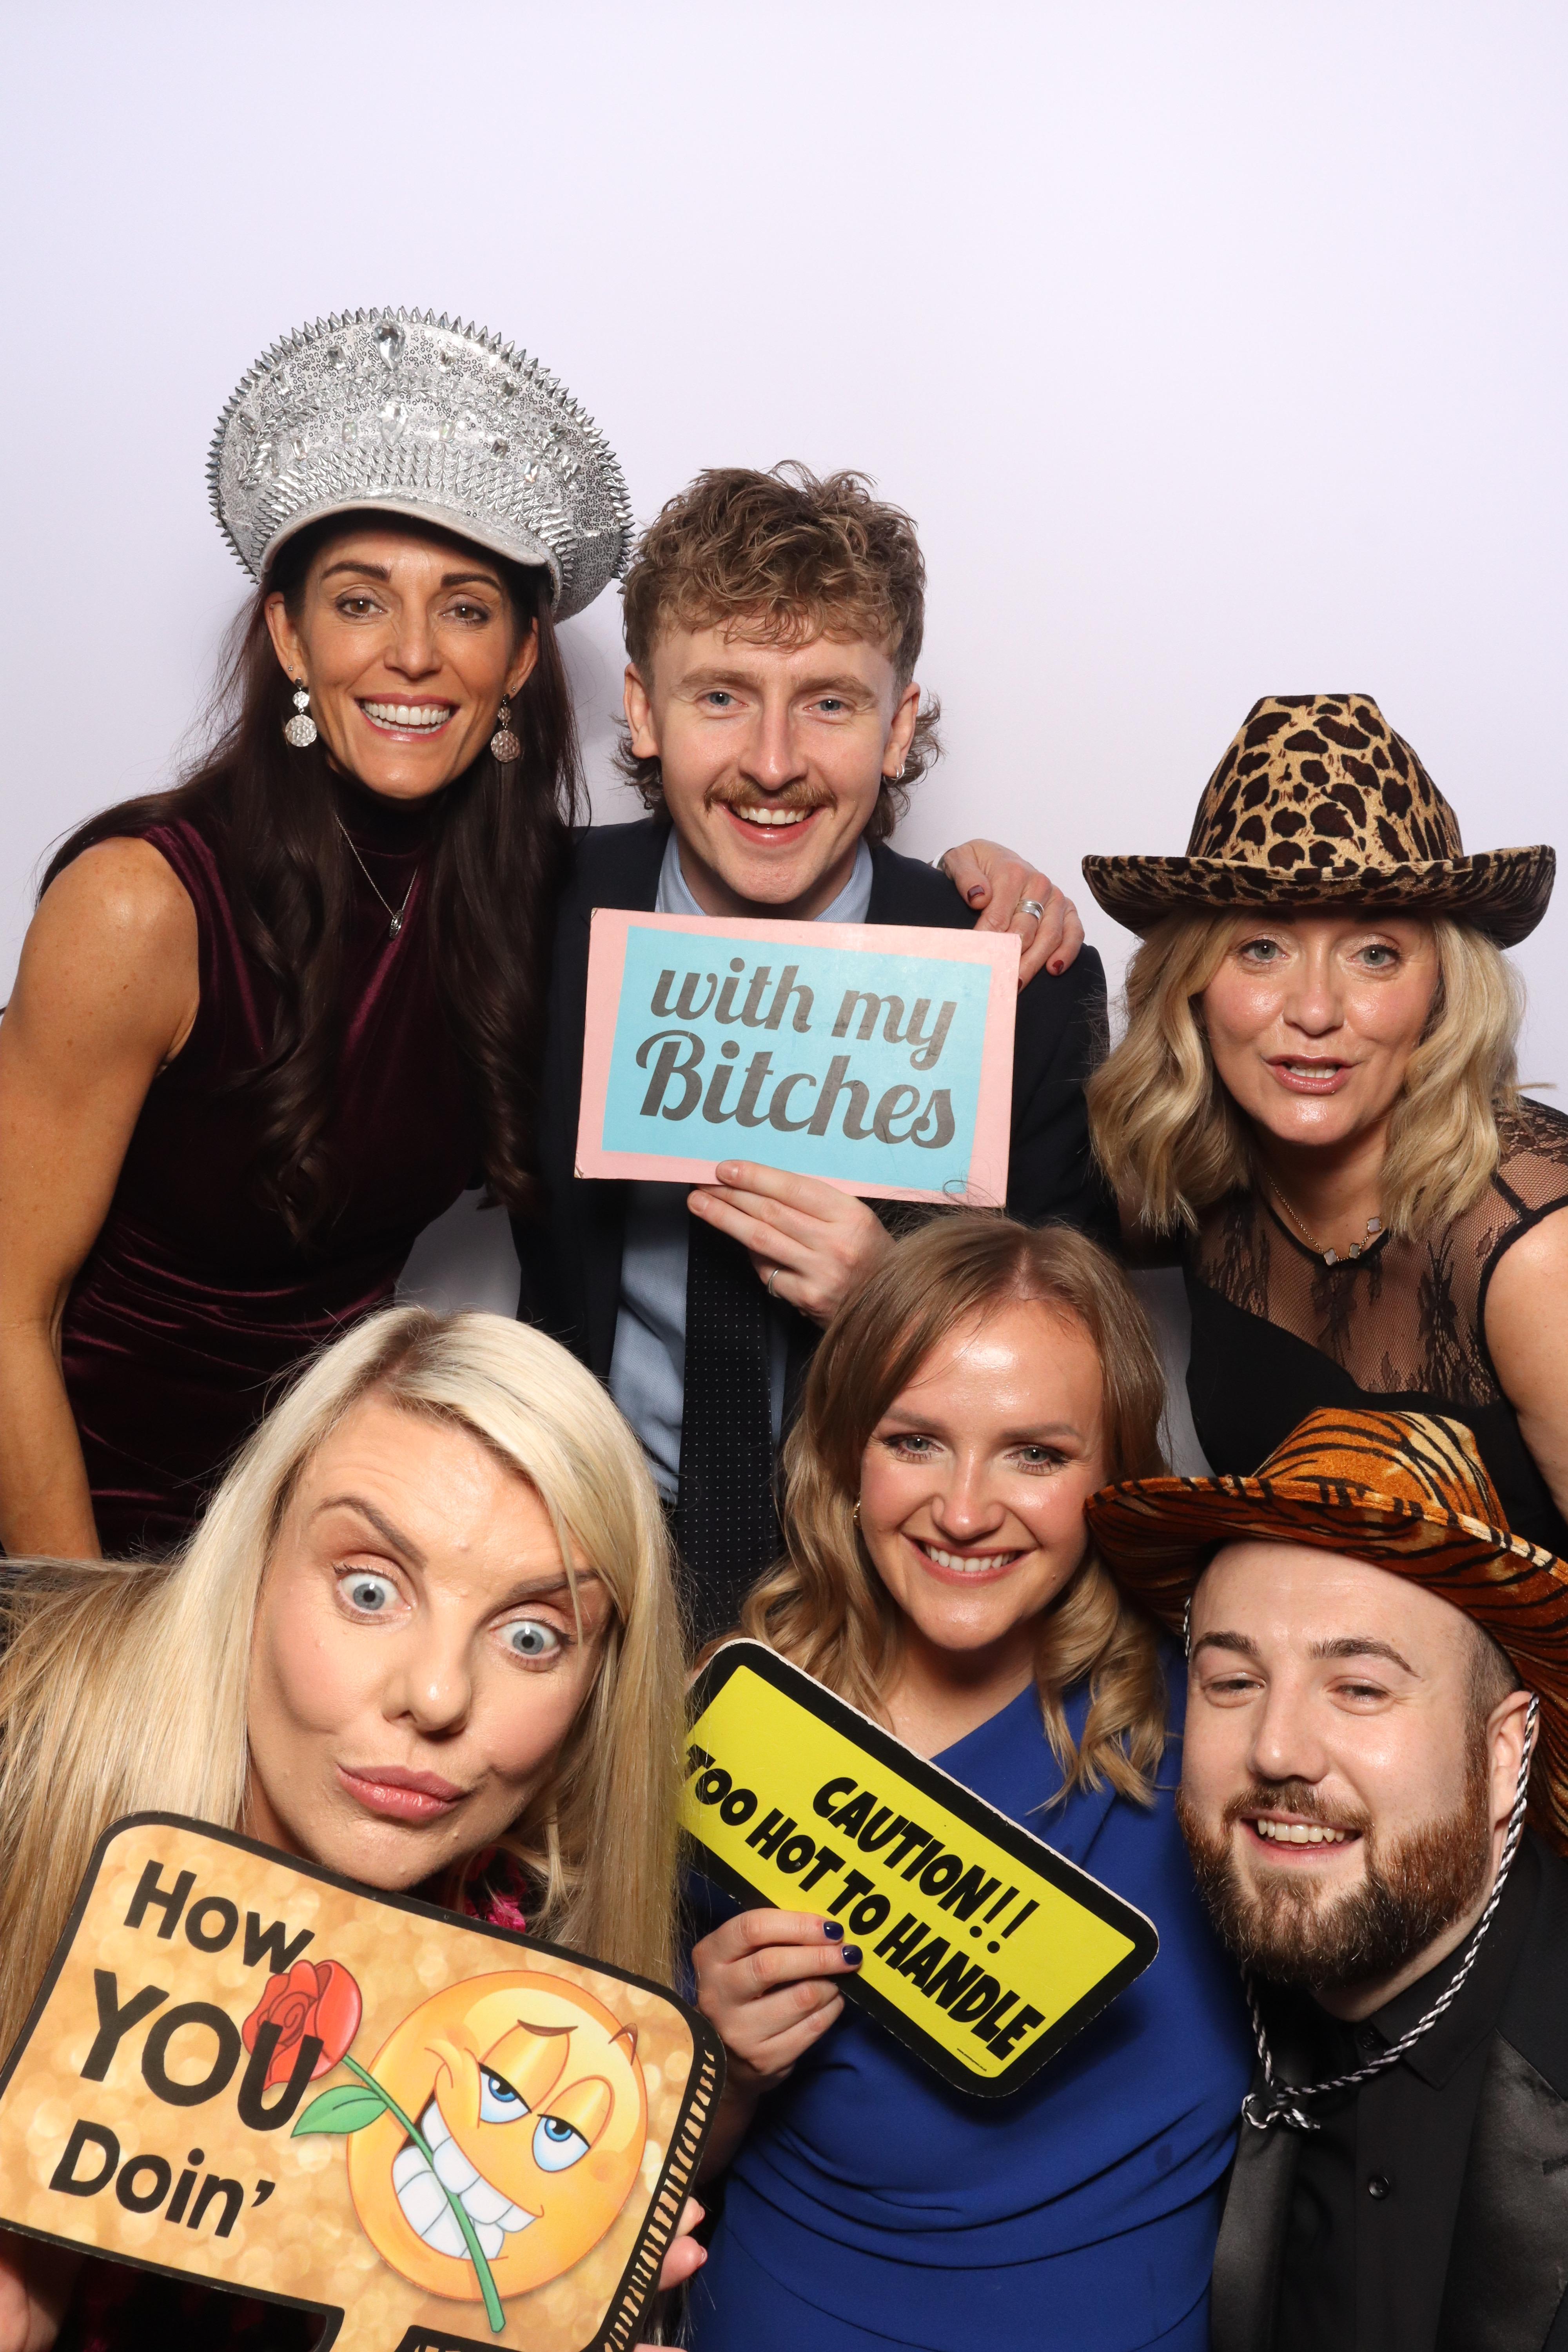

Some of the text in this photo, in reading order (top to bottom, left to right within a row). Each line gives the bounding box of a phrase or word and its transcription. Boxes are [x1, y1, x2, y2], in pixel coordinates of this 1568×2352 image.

[651, 957, 958, 1071] with my
[635, 1029, 956, 1149] Bitches
[123, 1859, 315, 1975] How
[685, 1743, 1047, 2062] TOO HOT TO HANDLE
[812, 1777, 1040, 1954] CAUTION!!
[80, 1968, 324, 2132] YOU
[48, 2119, 276, 2238] Doin’
